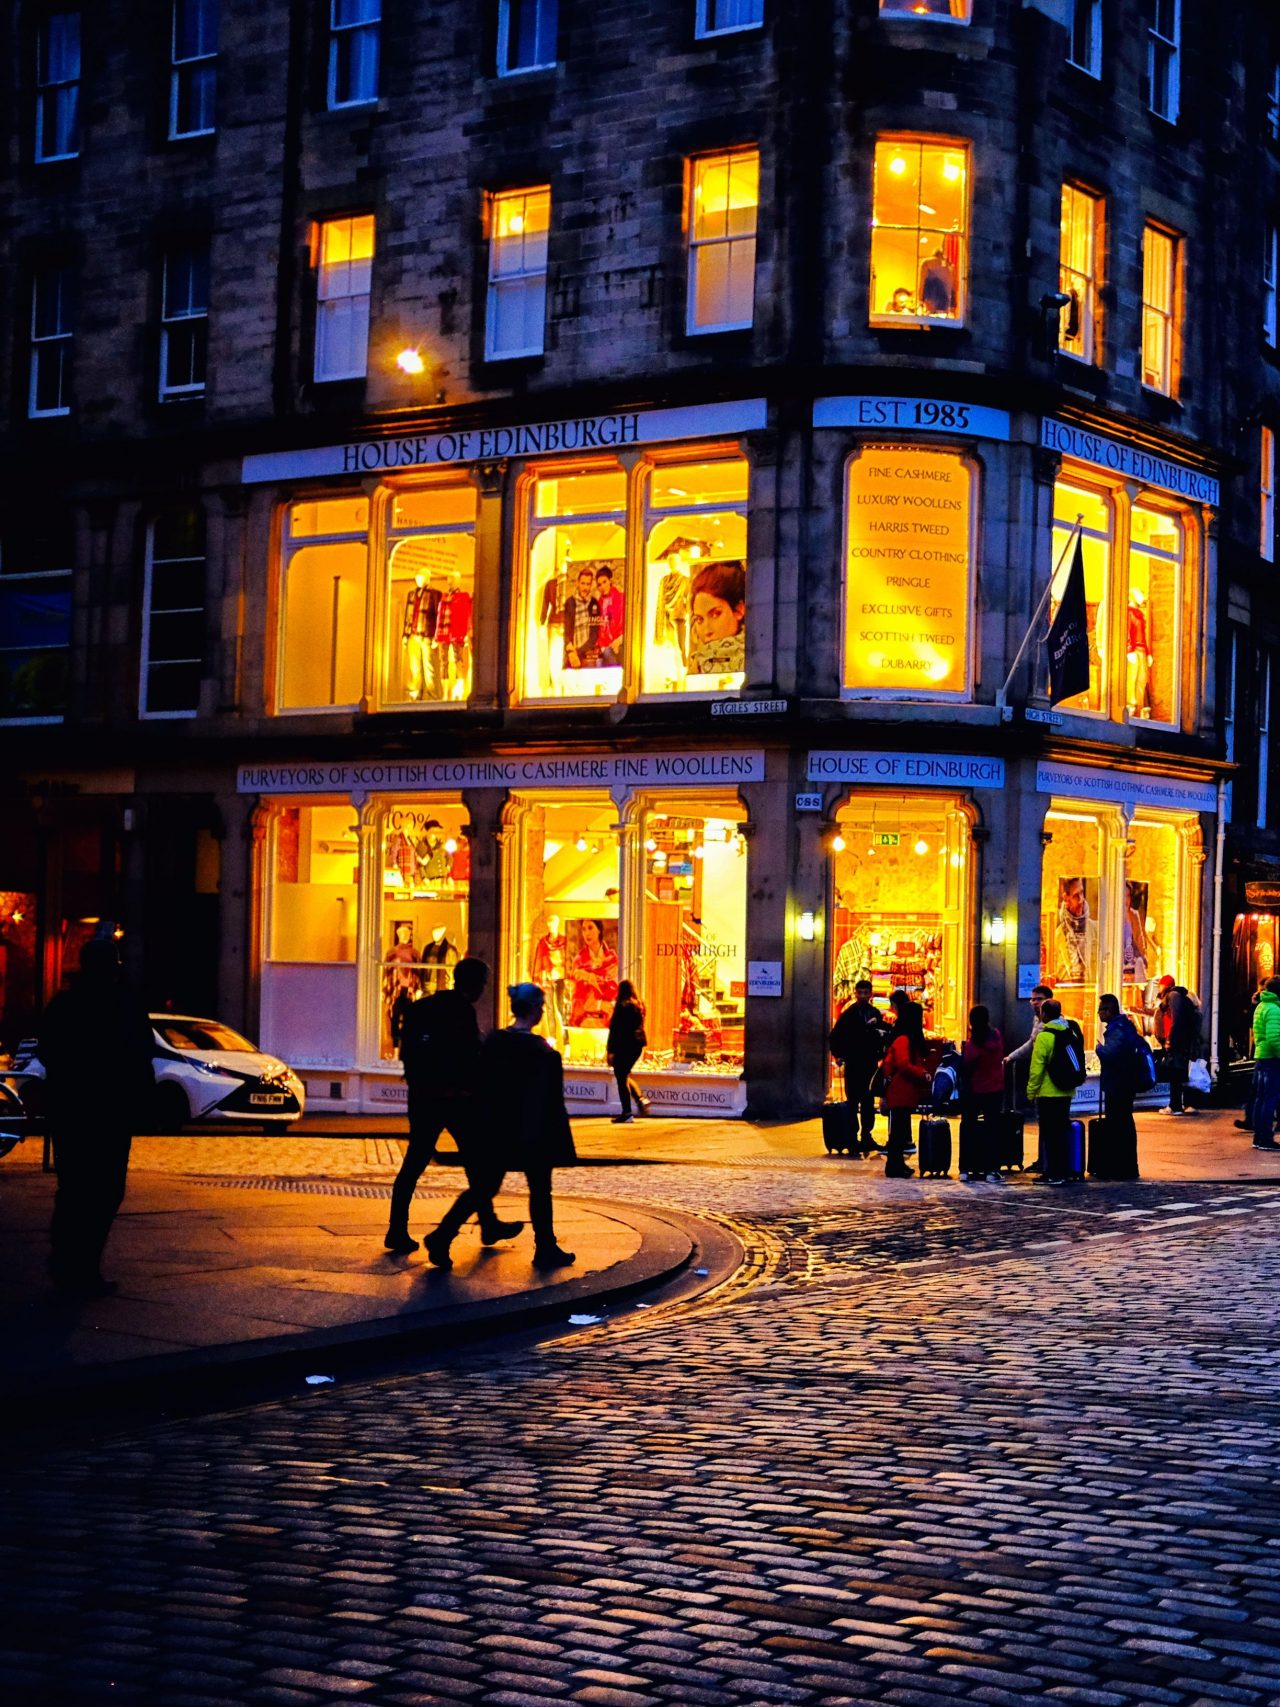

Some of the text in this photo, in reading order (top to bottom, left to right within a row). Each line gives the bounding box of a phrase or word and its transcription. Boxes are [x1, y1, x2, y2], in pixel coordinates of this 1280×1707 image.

[858, 400, 971, 429] EST 1985
[342, 414, 641, 472] HOUSE OF EDINBURGH
[1044, 420, 1219, 505] HOUSE OF EDINBURGH
[868, 467, 952, 482] FINE CASHMERE
[857, 495, 962, 511] LUXURY WOOLLENS
[869, 521, 950, 535] HARRIS TWEED
[851, 548, 965, 564] COUNTRY CLOTHING
[886, 576, 931, 588] PRINGLE
[861, 604, 953, 618] EXCLUSIVE GIFTS
[859, 631, 955, 645] SCOTTISH TWEED
[881, 658, 933, 671] DUBARRY
[754, 701, 785, 712] STREET
[242, 756, 753, 786] PURVEYORS OF SCOTTISH CLOTHING CASHMERE FINE WOOLLENS
[809, 757, 1001, 780] HOUSE OF EDINBURGH
[1038, 771, 1073, 786] PURVEYORS
[1084, 777, 1113, 789] SCOTTISH
[1114, 781, 1144, 794] CLOTHING
[1145, 784, 1174, 798] CASHMERE
[656, 943, 737, 957] EDINBURGH
[682, 1091, 726, 1104] CLOTHING
